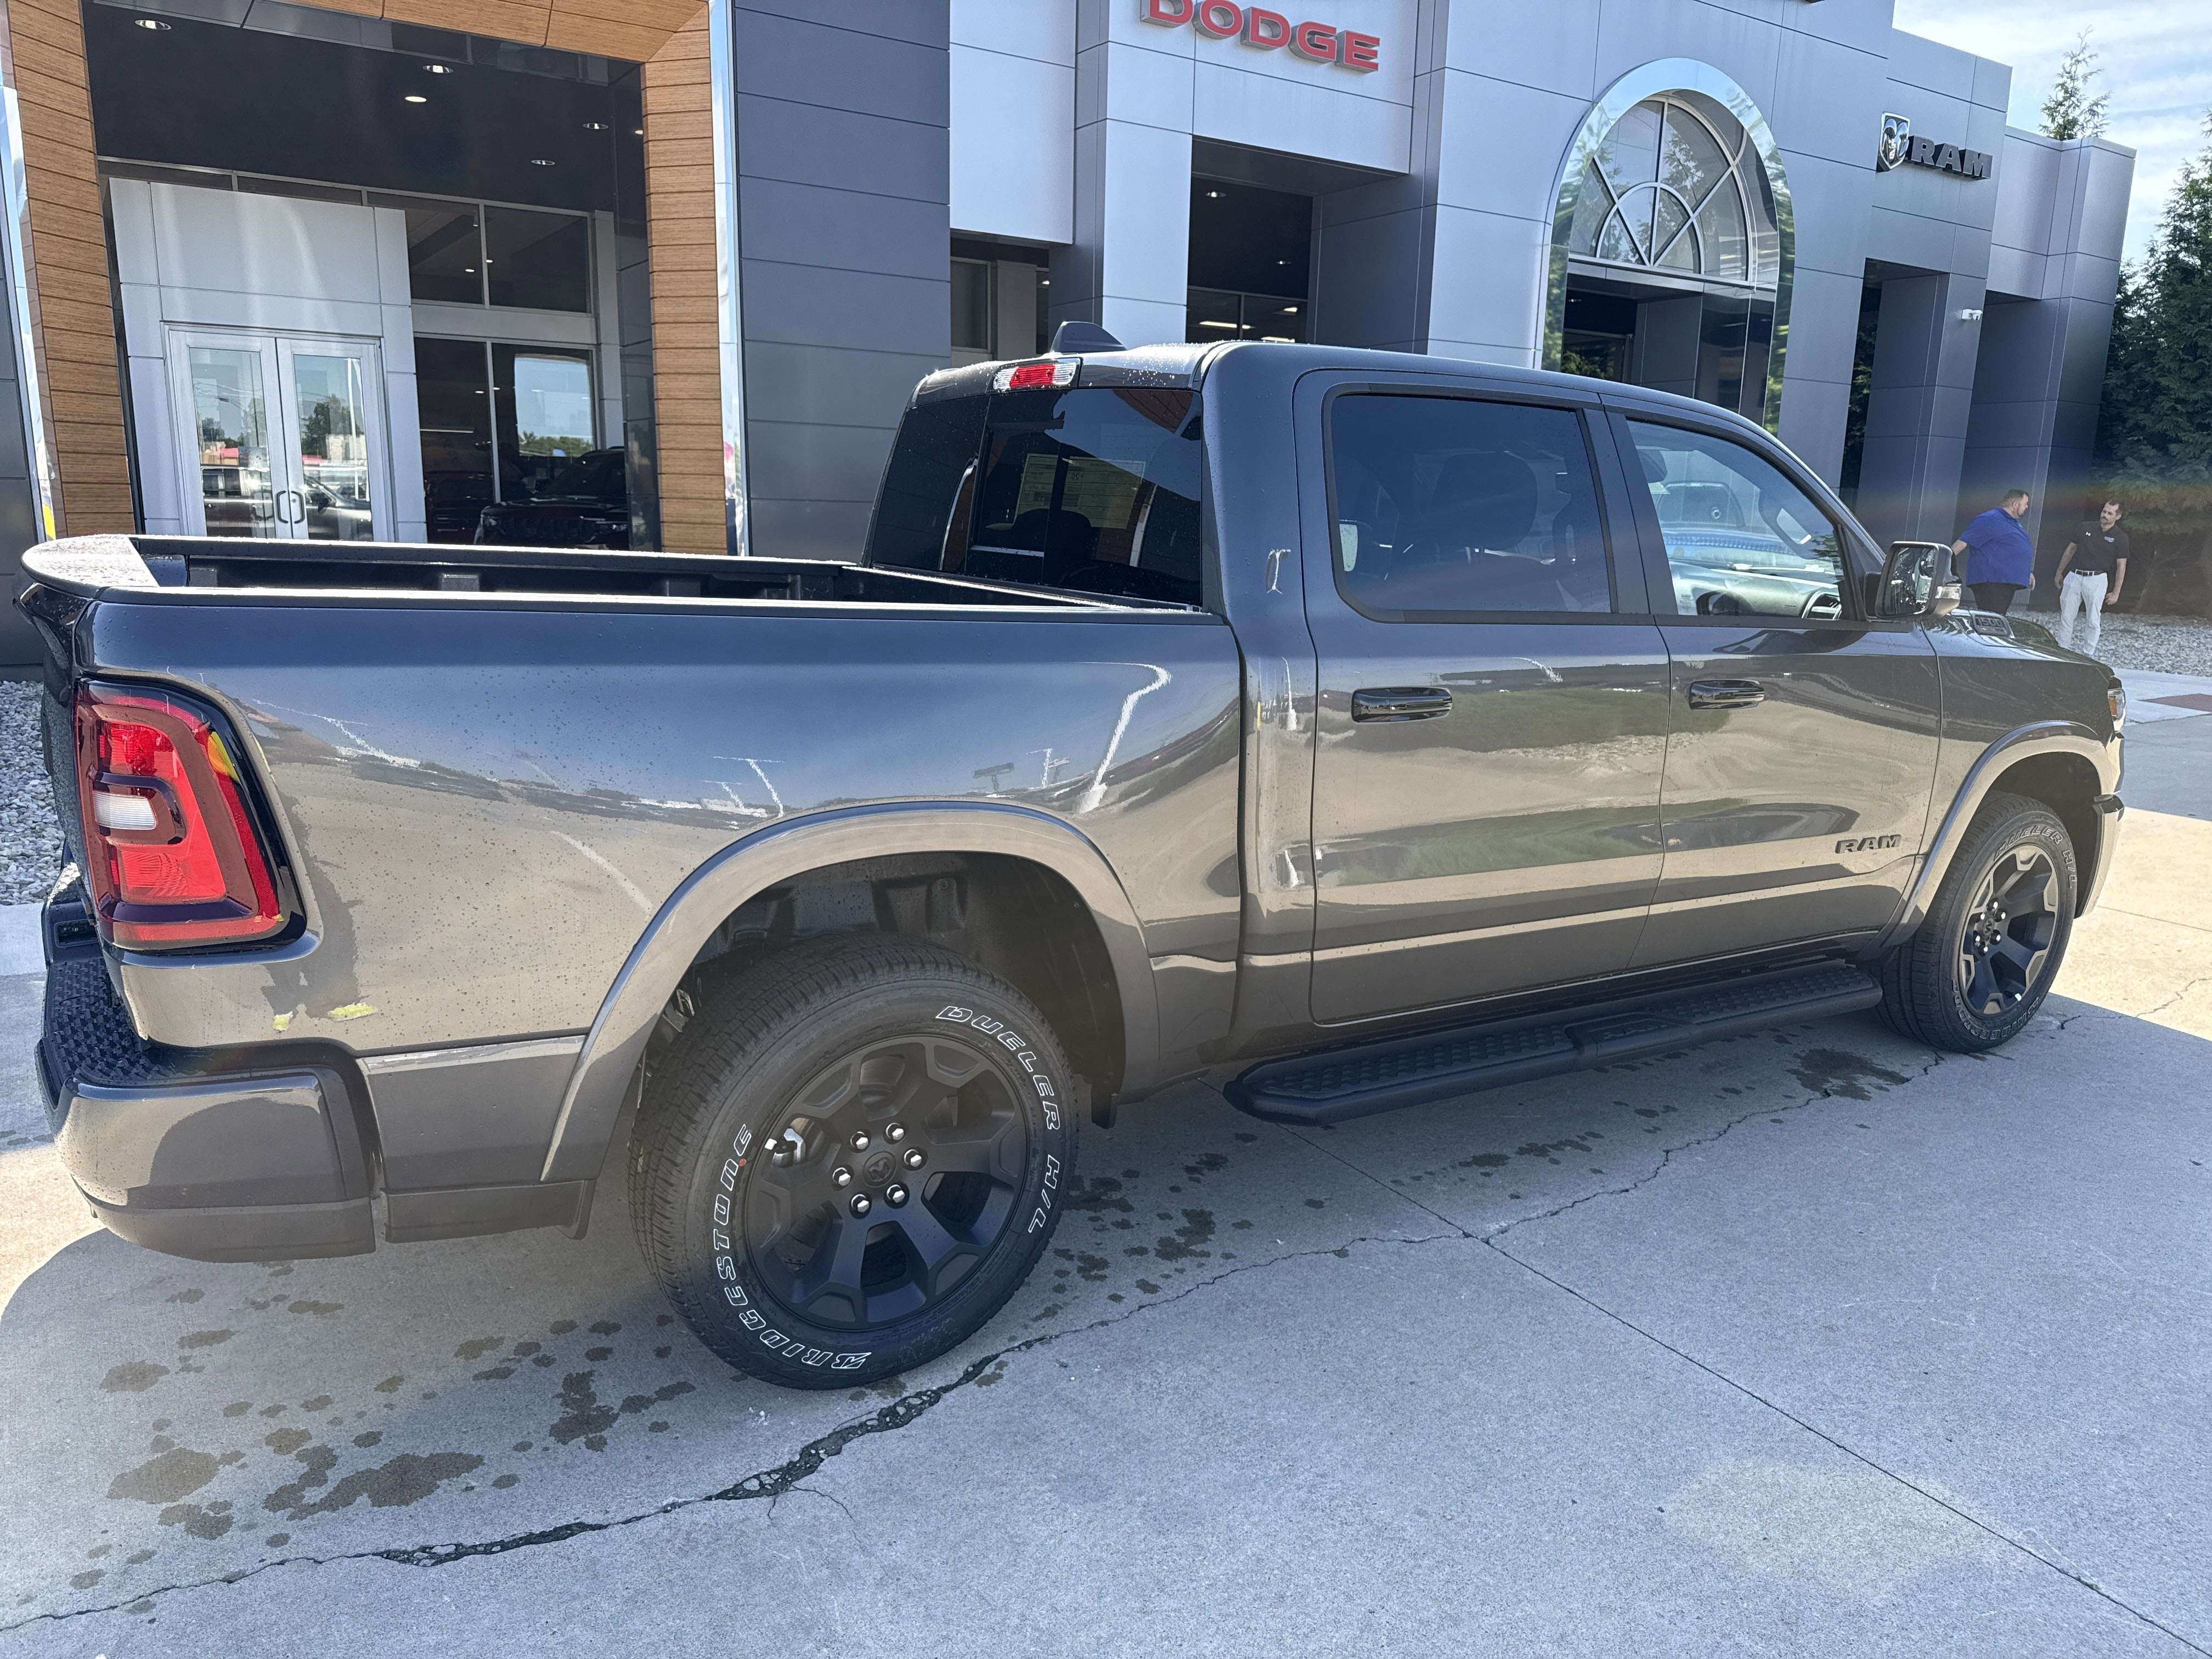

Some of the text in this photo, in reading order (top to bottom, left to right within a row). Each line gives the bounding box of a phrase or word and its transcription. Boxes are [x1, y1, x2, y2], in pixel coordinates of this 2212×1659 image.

[1142, 0, 1380, 72] DODGE
[1908, 135, 1993, 179] RAM
[1835, 834, 1902, 854] RAM
[1994, 825, 2063, 861] DUELER
[935, 1005, 1060, 1131] DUELER
[713, 1124, 872, 1370] BRIDGESTONE
